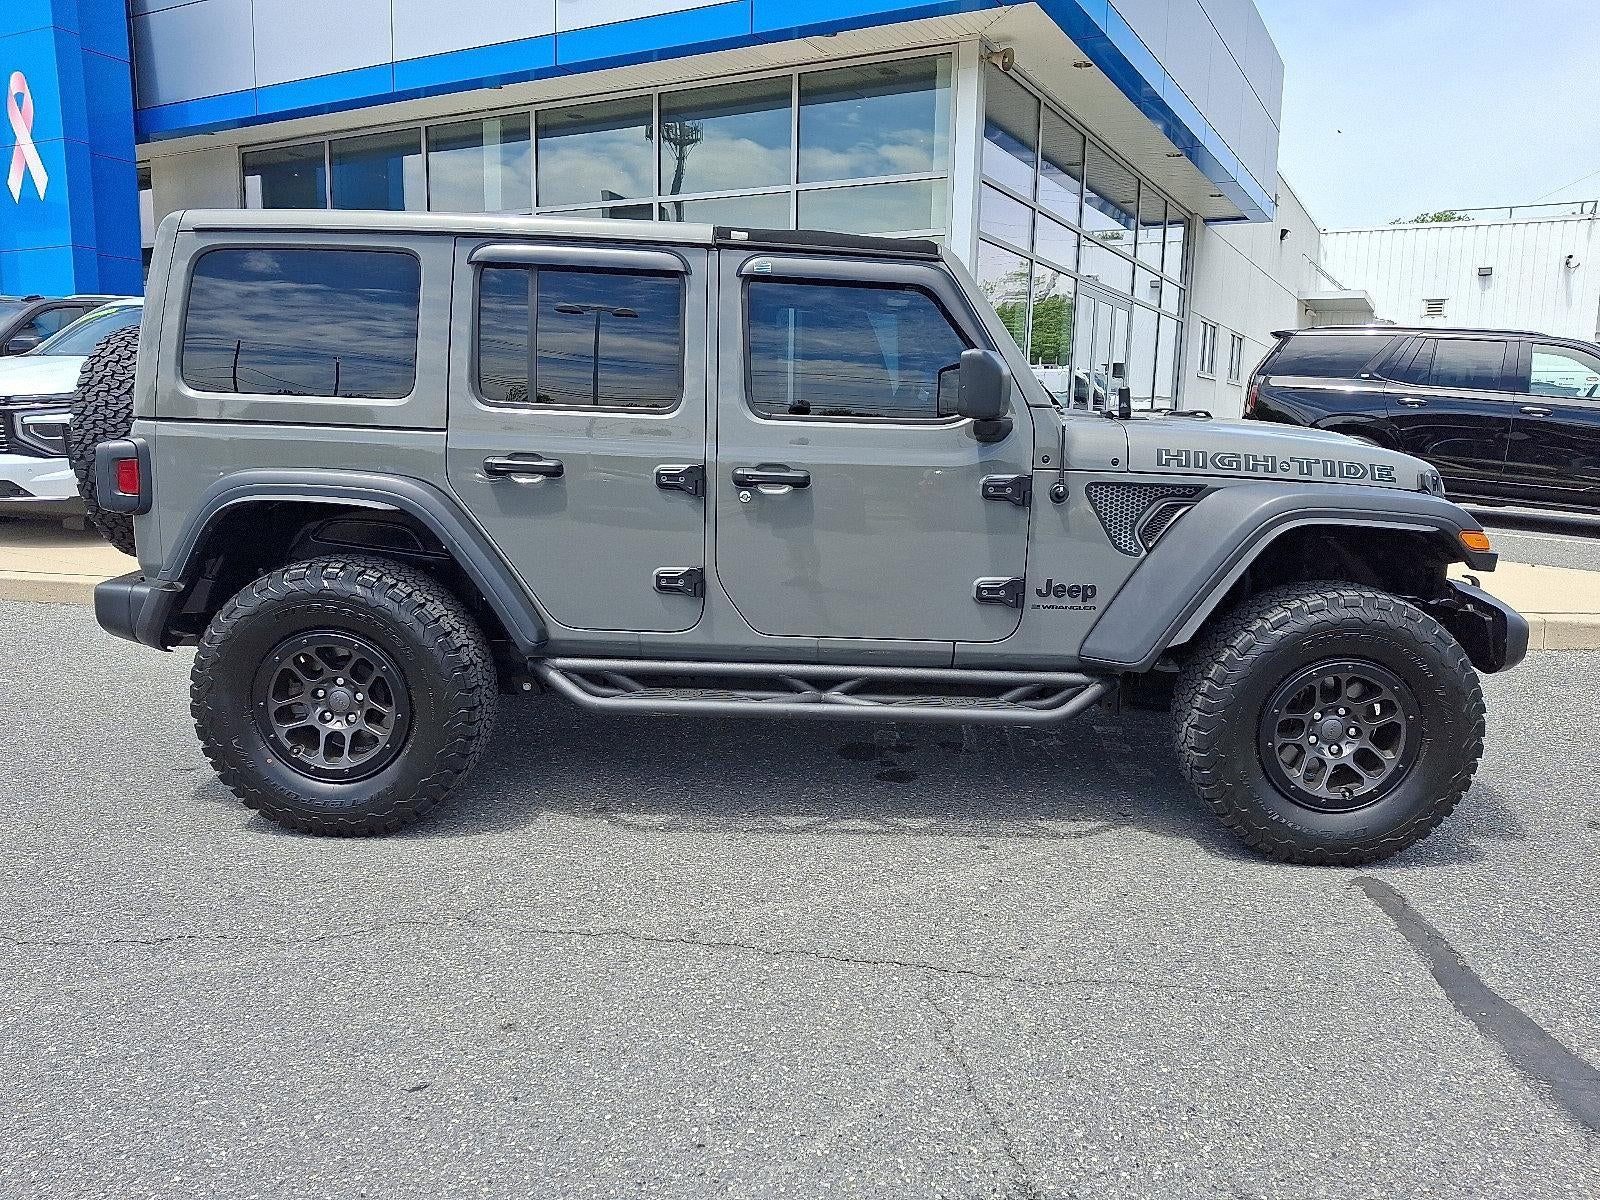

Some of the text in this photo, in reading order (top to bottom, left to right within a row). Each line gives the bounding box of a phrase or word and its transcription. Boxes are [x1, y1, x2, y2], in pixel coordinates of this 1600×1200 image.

[1156, 448, 1397, 483] HIGH TIDE
[1035, 578, 1097, 602] Jeep
